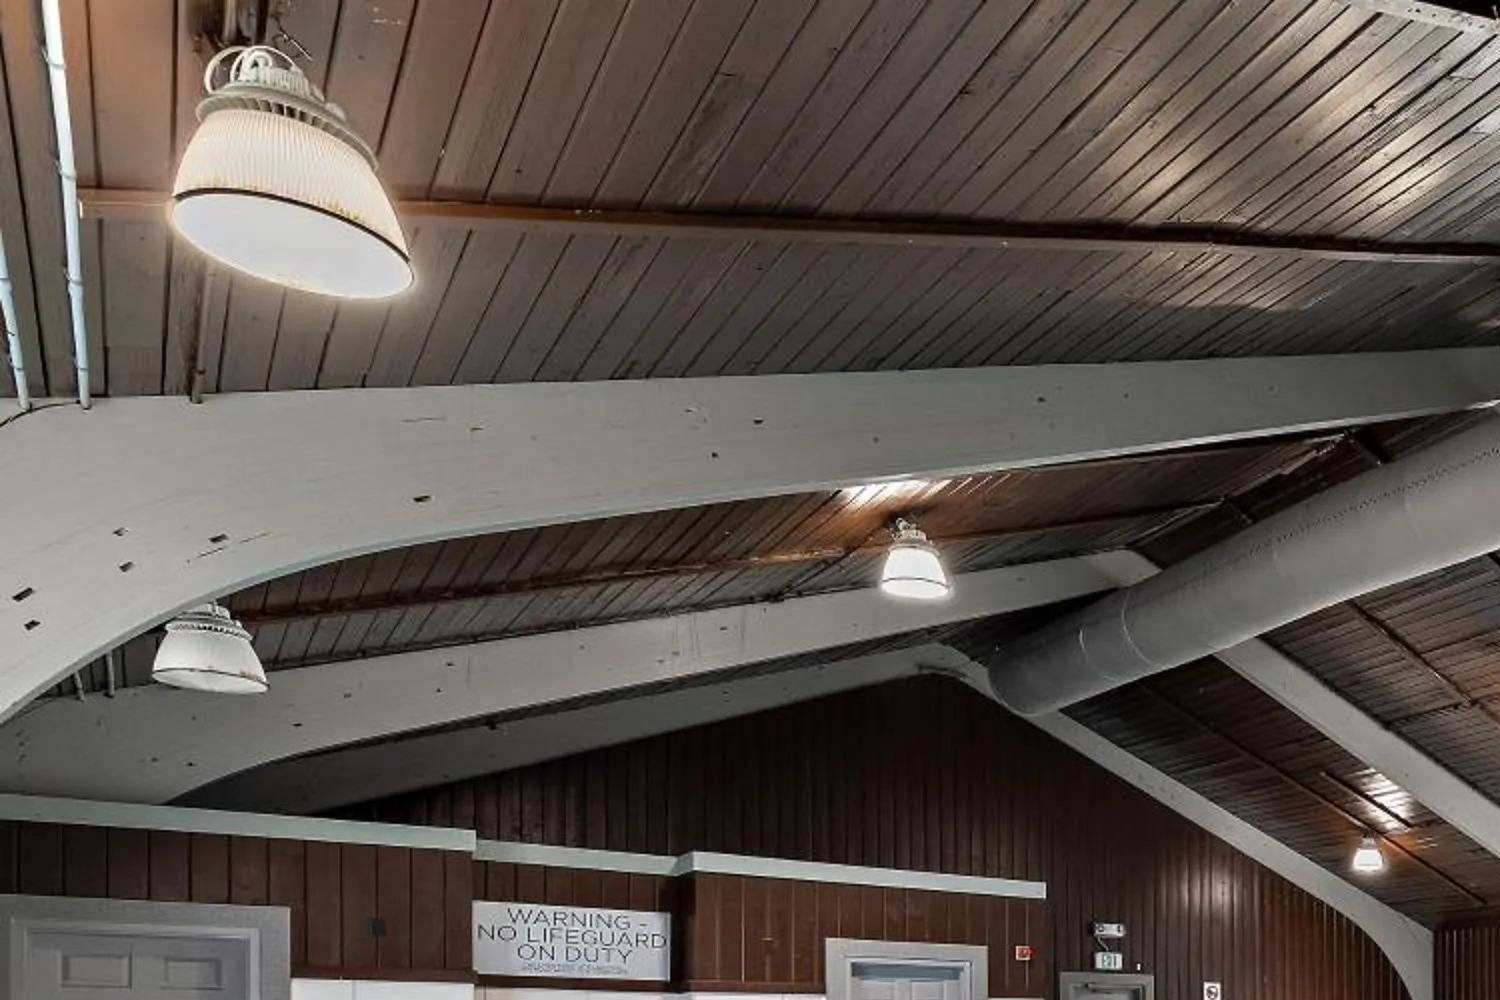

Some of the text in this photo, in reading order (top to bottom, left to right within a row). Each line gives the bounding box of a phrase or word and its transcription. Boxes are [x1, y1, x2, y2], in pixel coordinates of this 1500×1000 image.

[507, 908, 630, 929] WARNING
[477, 925, 667, 949] NO LIFEGUARD
[517, 944, 633, 965] ON DUTY
